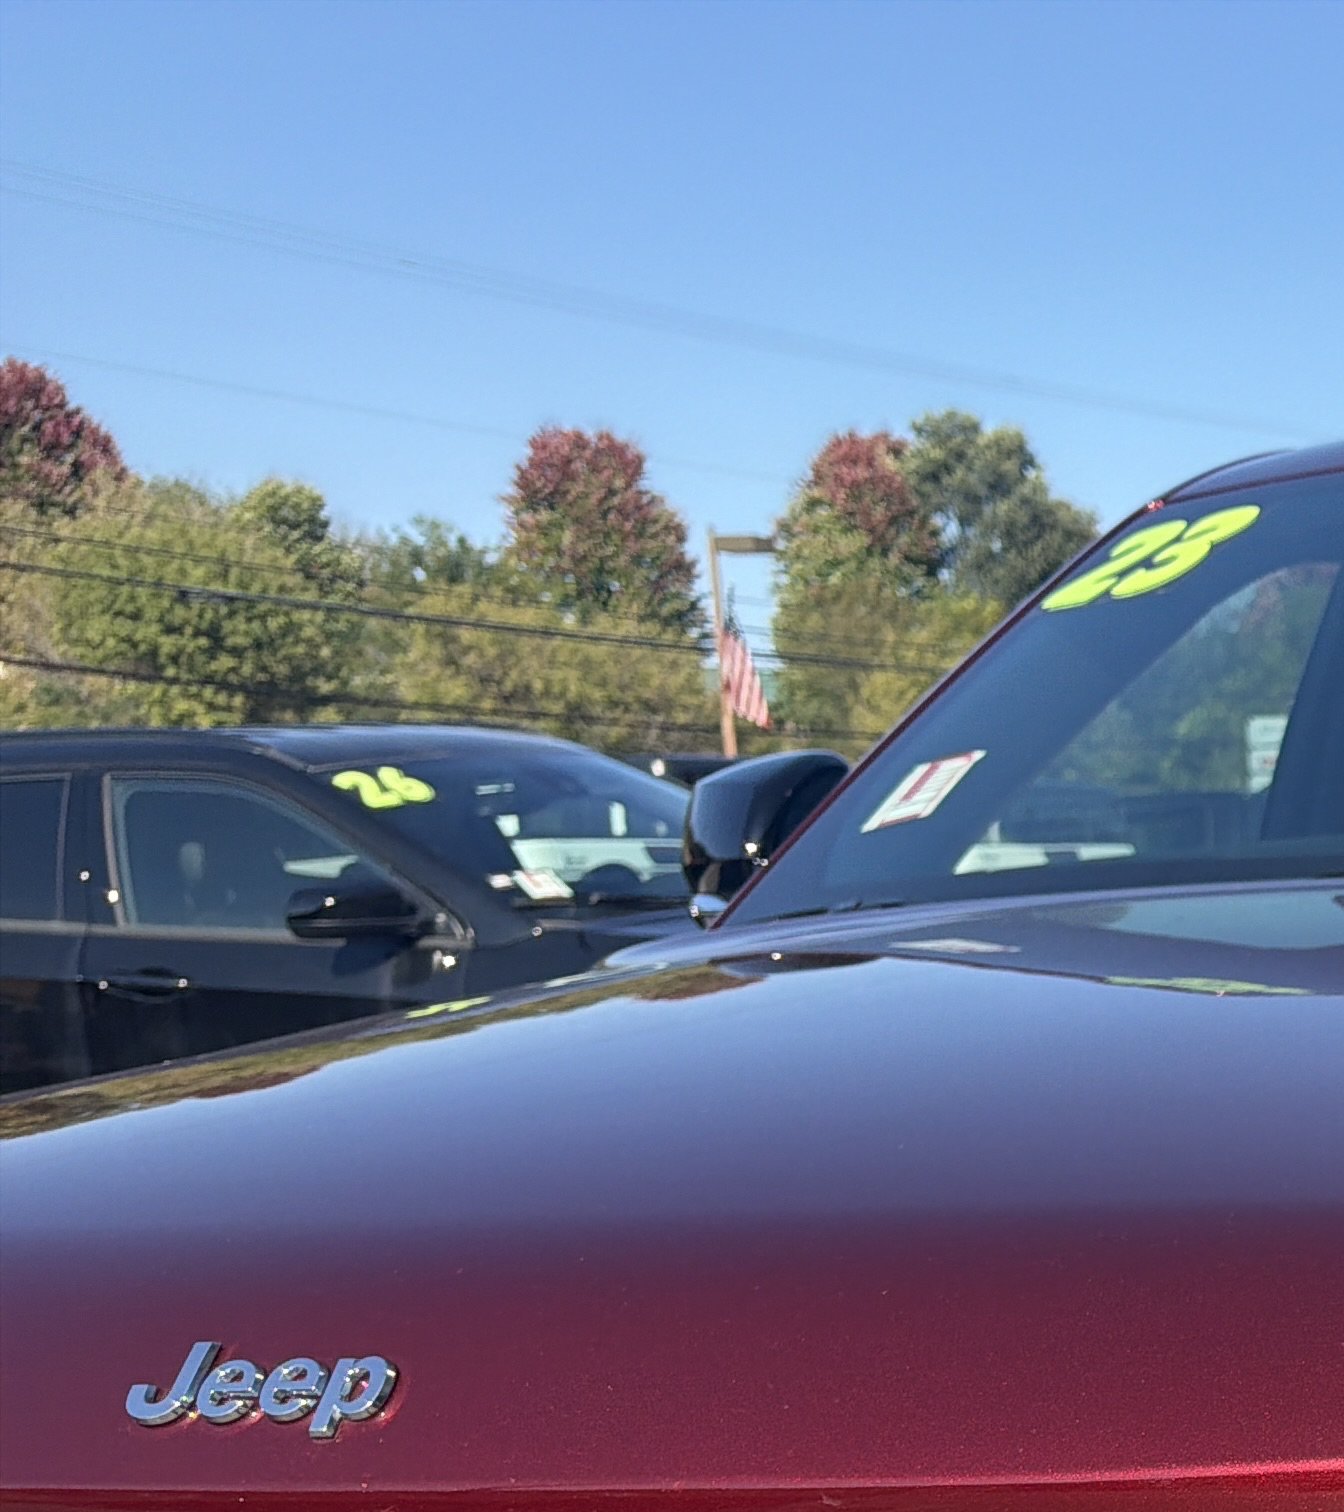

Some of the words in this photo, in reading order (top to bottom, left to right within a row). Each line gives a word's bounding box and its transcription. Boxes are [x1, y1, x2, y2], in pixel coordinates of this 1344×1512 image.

[1041, 504, 1261, 611] 23
[331, 766, 436, 809] 26
[125, 1341, 399, 1439] Jeep
